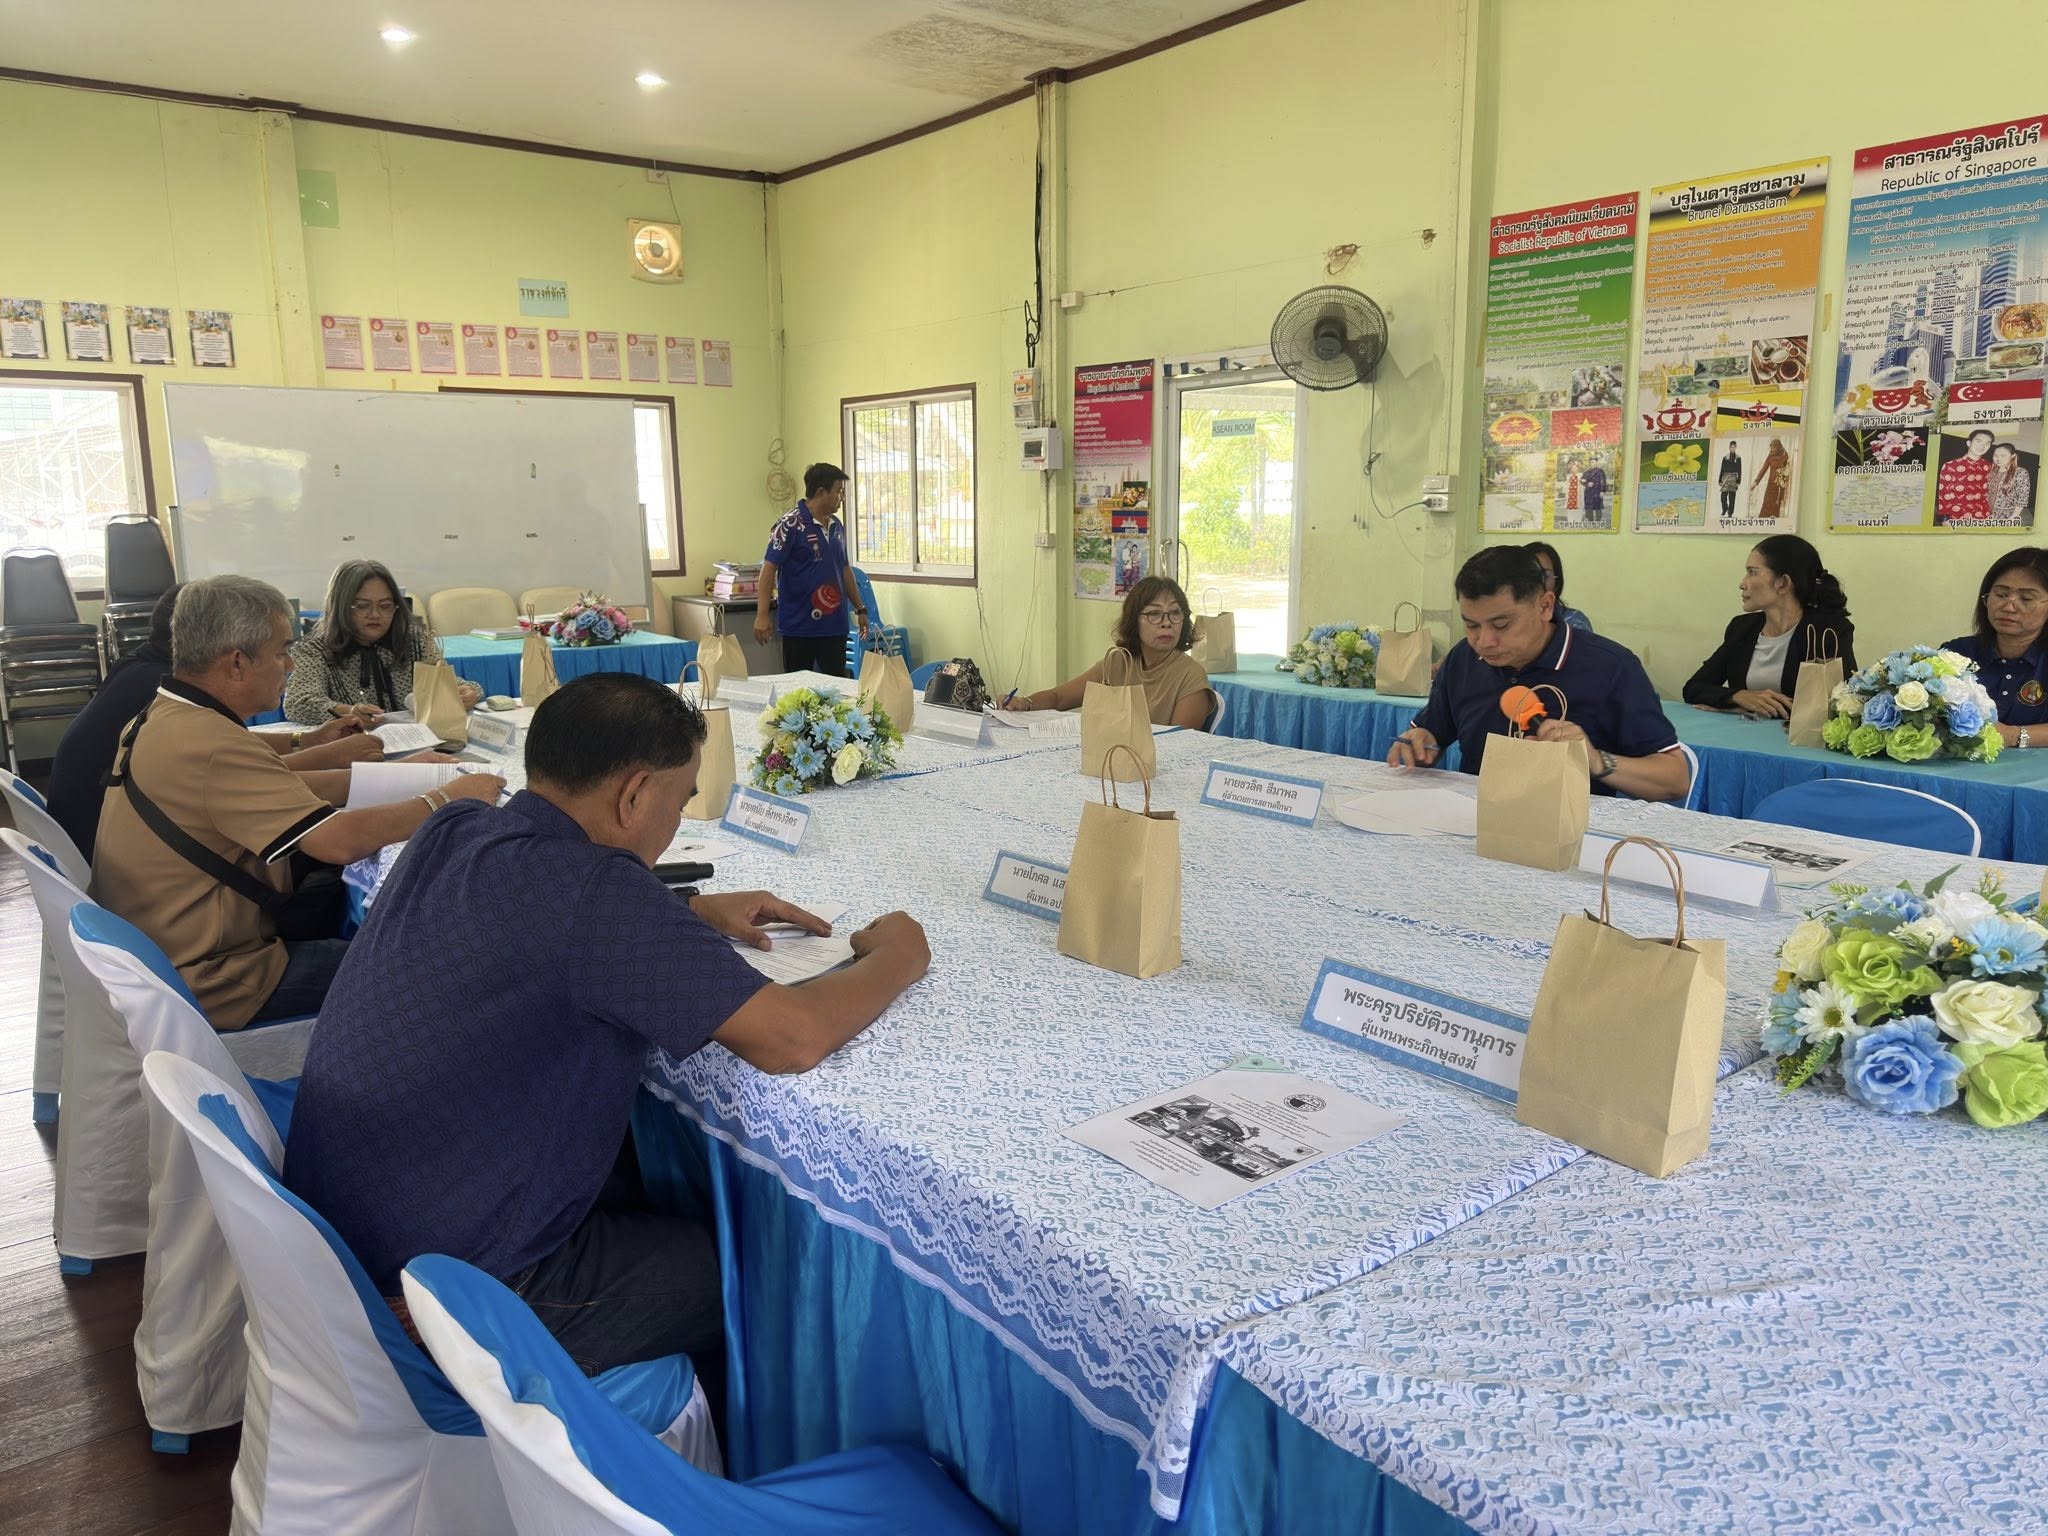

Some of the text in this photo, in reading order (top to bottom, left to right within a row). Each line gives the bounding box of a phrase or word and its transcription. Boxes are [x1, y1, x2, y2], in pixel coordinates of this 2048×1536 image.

[1884, 123, 2041, 170] สาธารณรัฐสิงคโปร์
[1881, 155, 2037, 192] Republic of Singapore
[1670, 173, 1806, 211] บรูไนดารุสซาลาม
[1688, 196, 1788, 222] Brunei Darussalam
[1492, 203, 1635, 234] สาธารณรัฐสังคมนิยมเวียดนาม
[1499, 224, 1628, 254] Socialist Republic of Vietnam
[520, 284, 566, 300] ราชวงศ์จักรี
[1863, 413, 1914, 427] ตราแผ่นดิน
[1973, 405, 2012, 420] ธงชาติ
[1212, 422, 1255, 434] ASEAN ROOM
[1743, 418, 1772, 430] ธงชาติ
[1656, 515, 1679, 526] แผนที่
[1719, 516, 1776, 530] ชุดประจำชาติ
[1857, 515, 1889, 527] แผนที่
[1949, 516, 2021, 530] ชุดประจำชาติ
[1223, 777, 1262, 793] นายชวลิต
[1221, 791, 1293, 813] ผู้อำนวยการสถานศึกษา
[1013, 865, 1067, 890] นายโกศล แส
[1026, 889, 1049, 905] ผู้แทน
[1343, 987, 1517, 1058] พระครูปริยัติวรานุการ
[1360, 1017, 1479, 1071] ผู้แทนพระภิกษุสงฆ์
